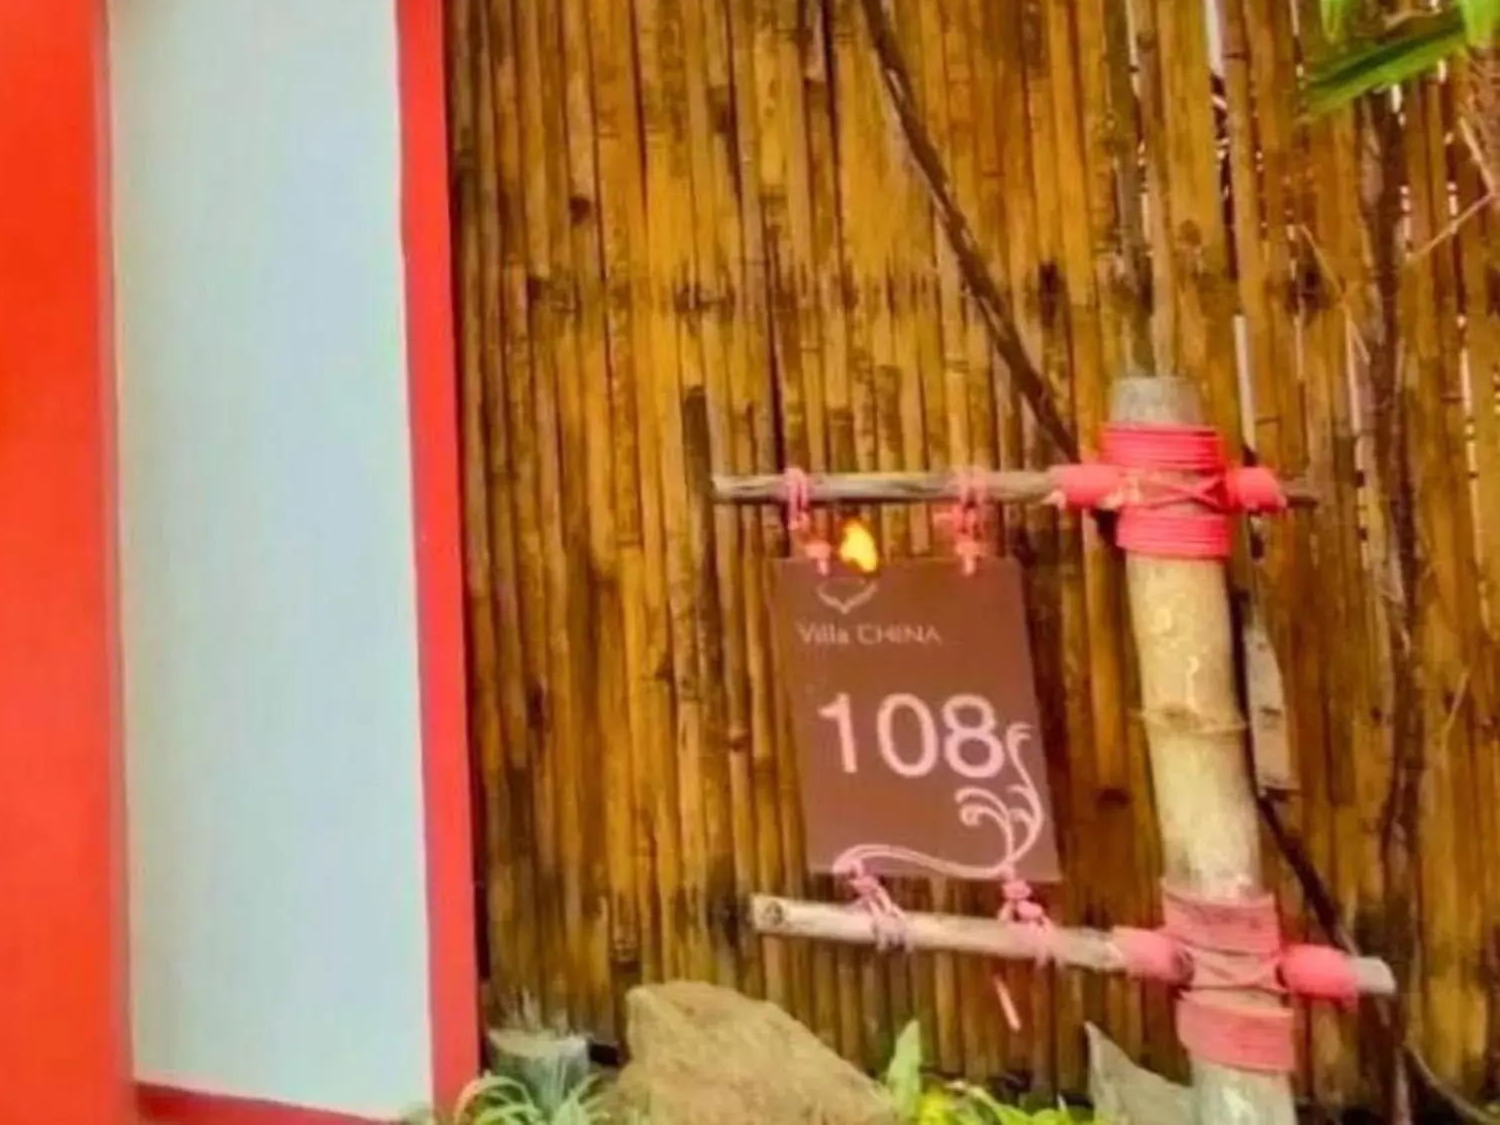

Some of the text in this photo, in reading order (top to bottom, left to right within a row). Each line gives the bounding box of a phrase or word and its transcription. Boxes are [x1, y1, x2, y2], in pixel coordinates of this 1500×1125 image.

[797, 623, 941, 646] Villa CHINA
[817, 692, 1004, 778] 108
